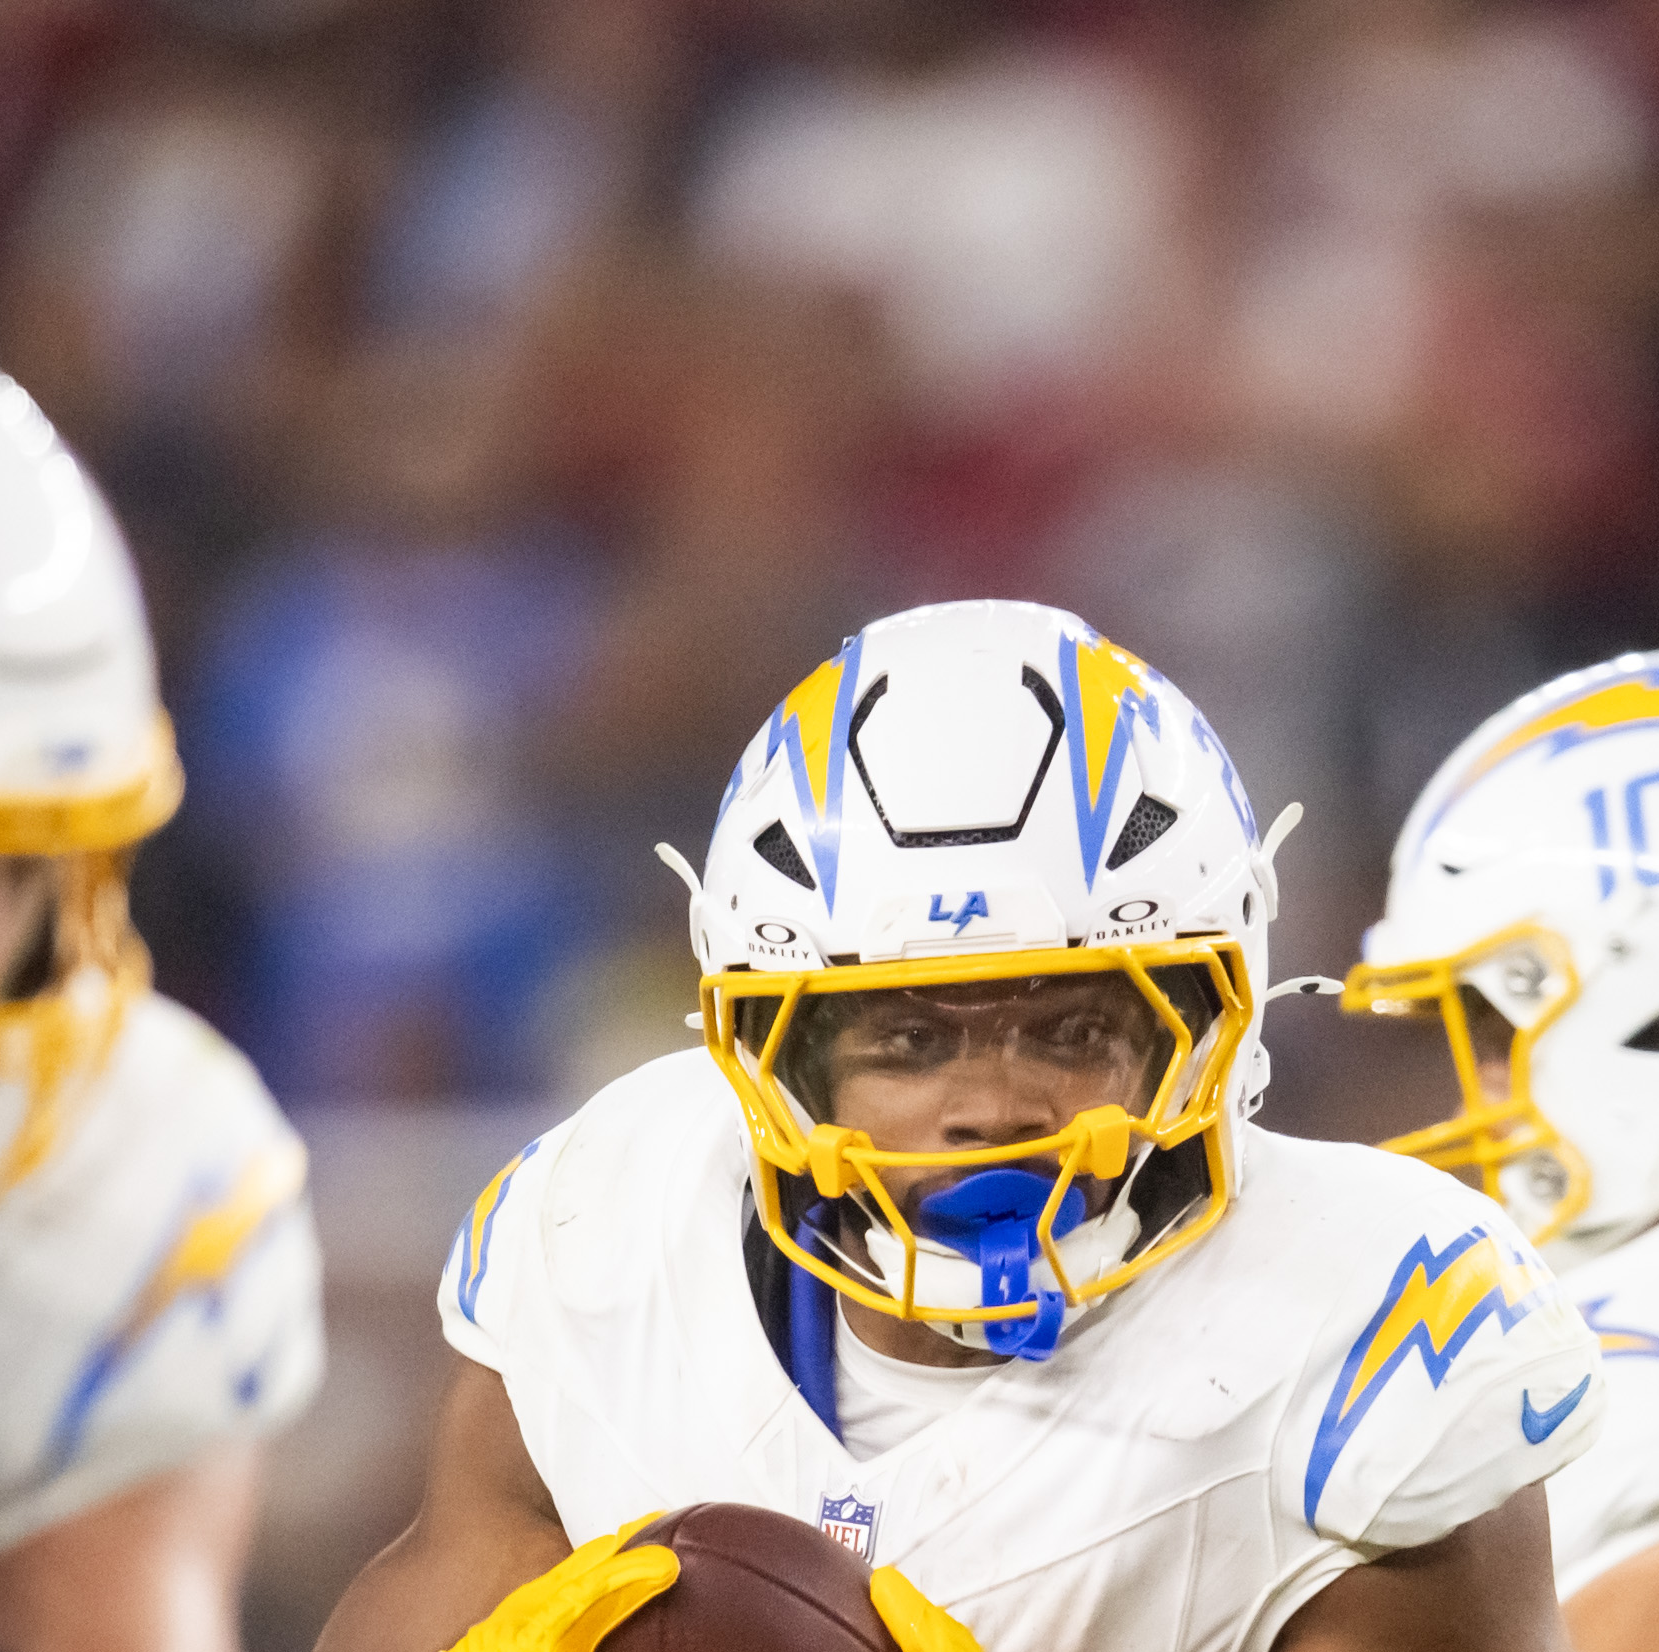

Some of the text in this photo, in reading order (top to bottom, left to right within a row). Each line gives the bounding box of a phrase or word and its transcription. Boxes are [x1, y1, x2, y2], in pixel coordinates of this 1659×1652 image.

[928, 890, 989, 937] LA
[1096, 918, 1170, 940] OAKLEY
[748, 942, 809, 960] OAKLEY
